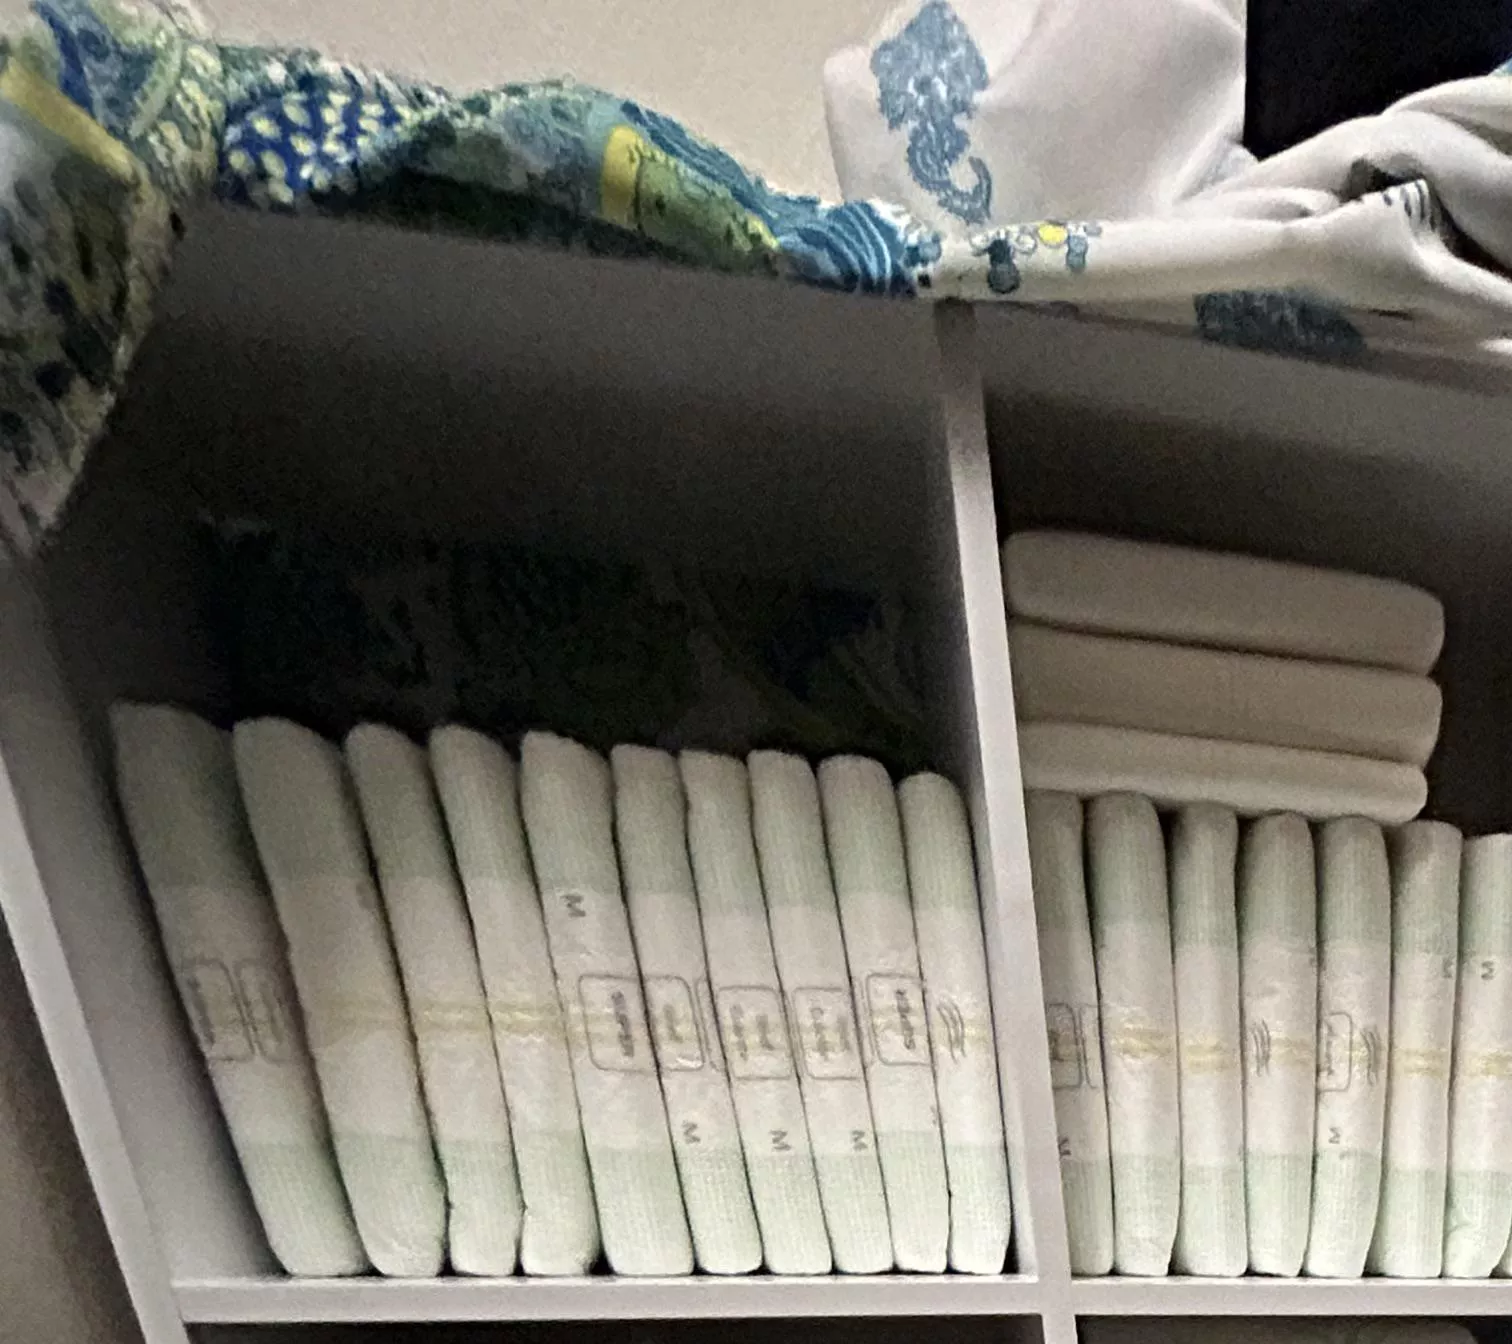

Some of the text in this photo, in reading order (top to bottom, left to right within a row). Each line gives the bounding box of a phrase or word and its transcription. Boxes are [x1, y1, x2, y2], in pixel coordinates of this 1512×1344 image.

[1480, 961, 1495, 981] M
[769, 1130, 792, 1152] M
[1328, 1127, 1341, 1144] M
